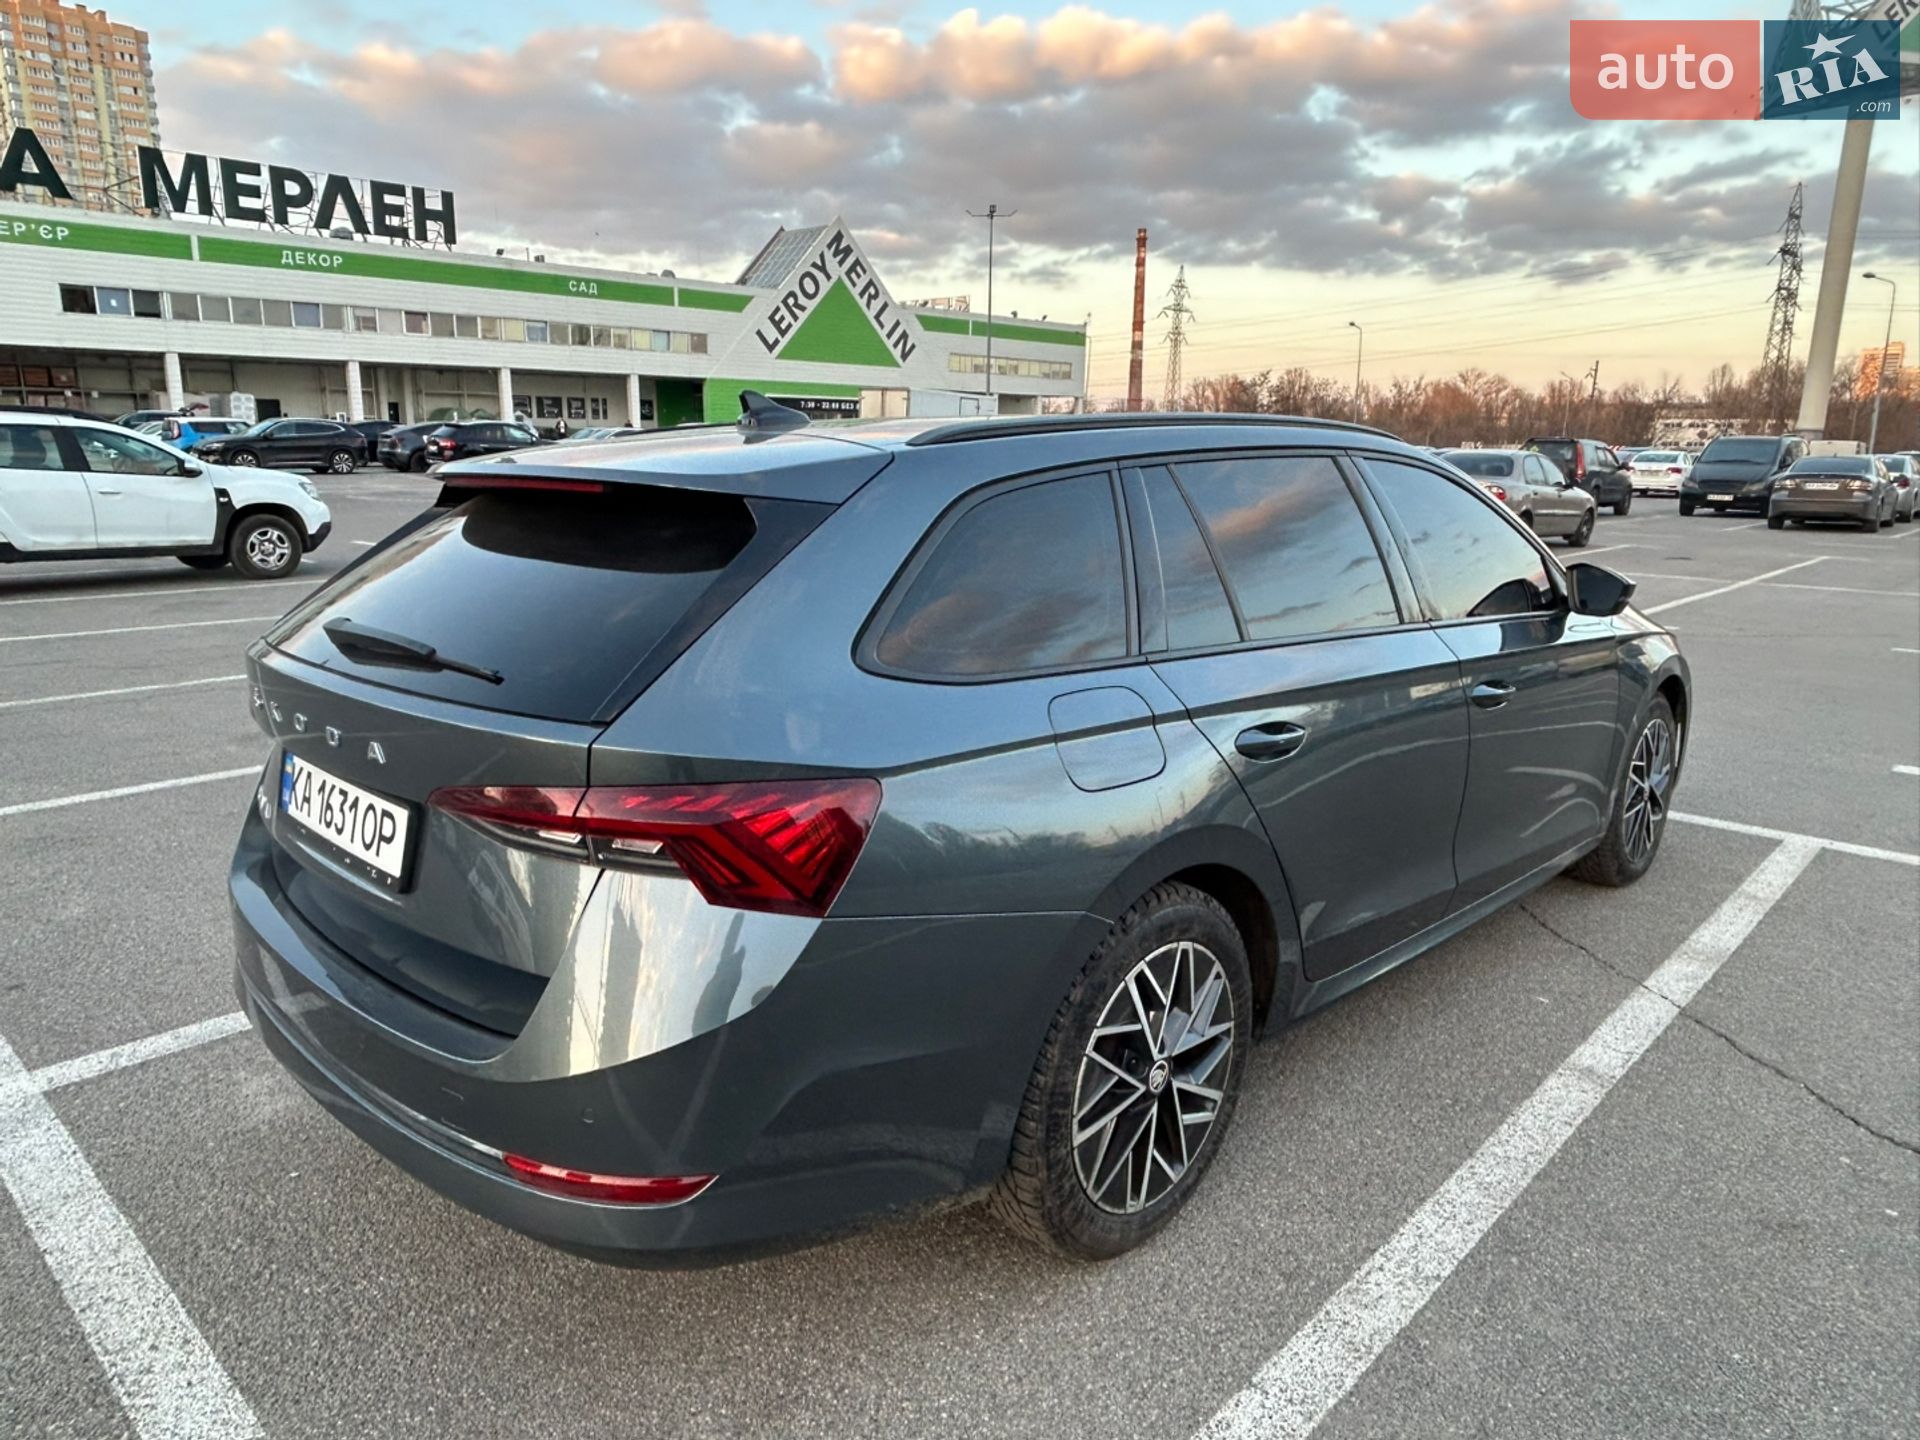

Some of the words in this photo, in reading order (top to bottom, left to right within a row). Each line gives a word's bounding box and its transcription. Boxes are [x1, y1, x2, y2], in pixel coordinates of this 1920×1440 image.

[136, 145, 457, 245] МЕРЛЕН
[281, 250, 343, 267] ДЕКОР
[568, 280, 598, 296] САД
[755, 251, 832, 354] LEROY
[826, 229, 916, 363] MERLIN
